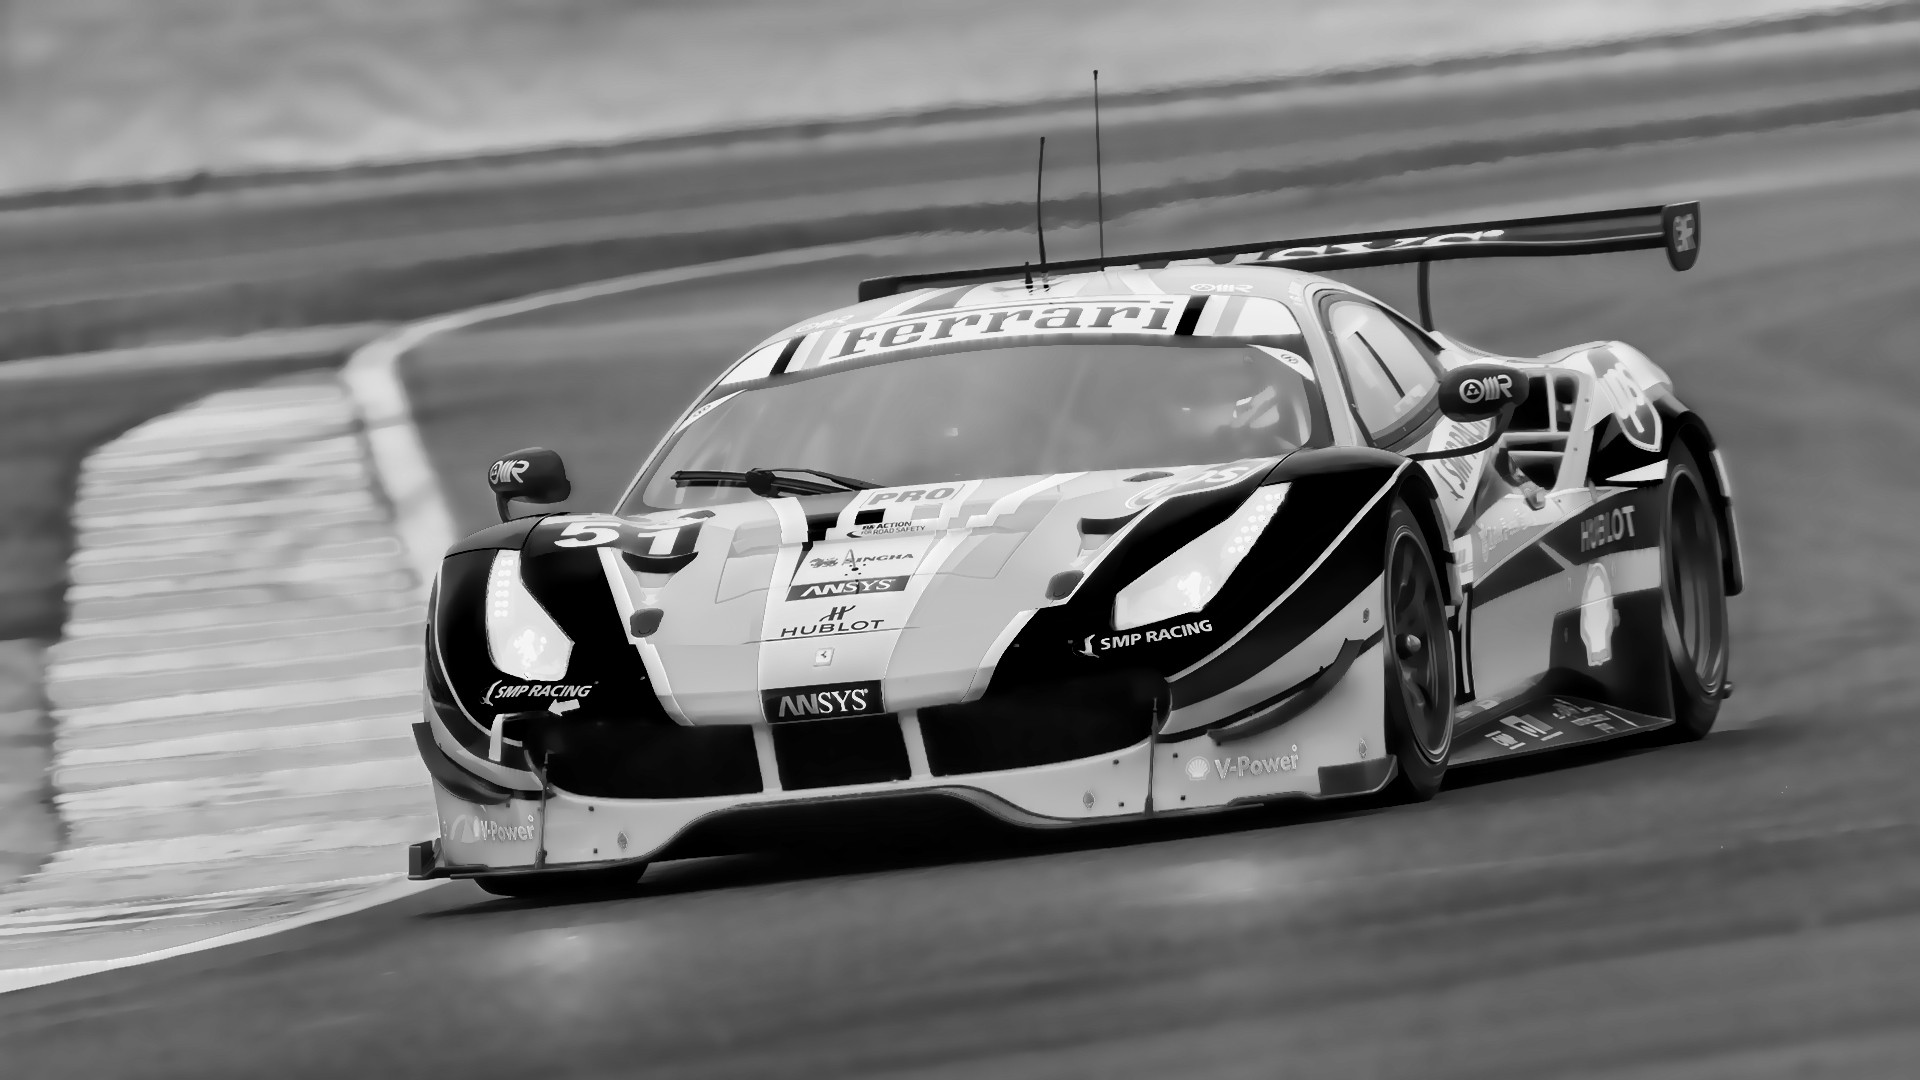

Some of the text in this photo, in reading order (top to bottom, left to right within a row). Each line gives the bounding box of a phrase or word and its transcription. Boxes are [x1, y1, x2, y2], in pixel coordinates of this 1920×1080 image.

[828, 300, 1173, 360] Ferrari
[867, 487, 955, 506] PRO
[876, 521, 912, 530] ACTION
[895, 525, 926, 534] SAFETY
[554, 522, 681, 555] 51
[800, 578, 893, 598] ANSYS
[780, 619, 885, 638] HUBLOT
[1100, 619, 1213, 651] SMP RACING
[494, 684, 593, 699] SMP RACING
[778, 688, 868, 718] ANSYS
[1214, 754, 1299, 780] V-Power
[479, 820, 535, 842] V-Power
